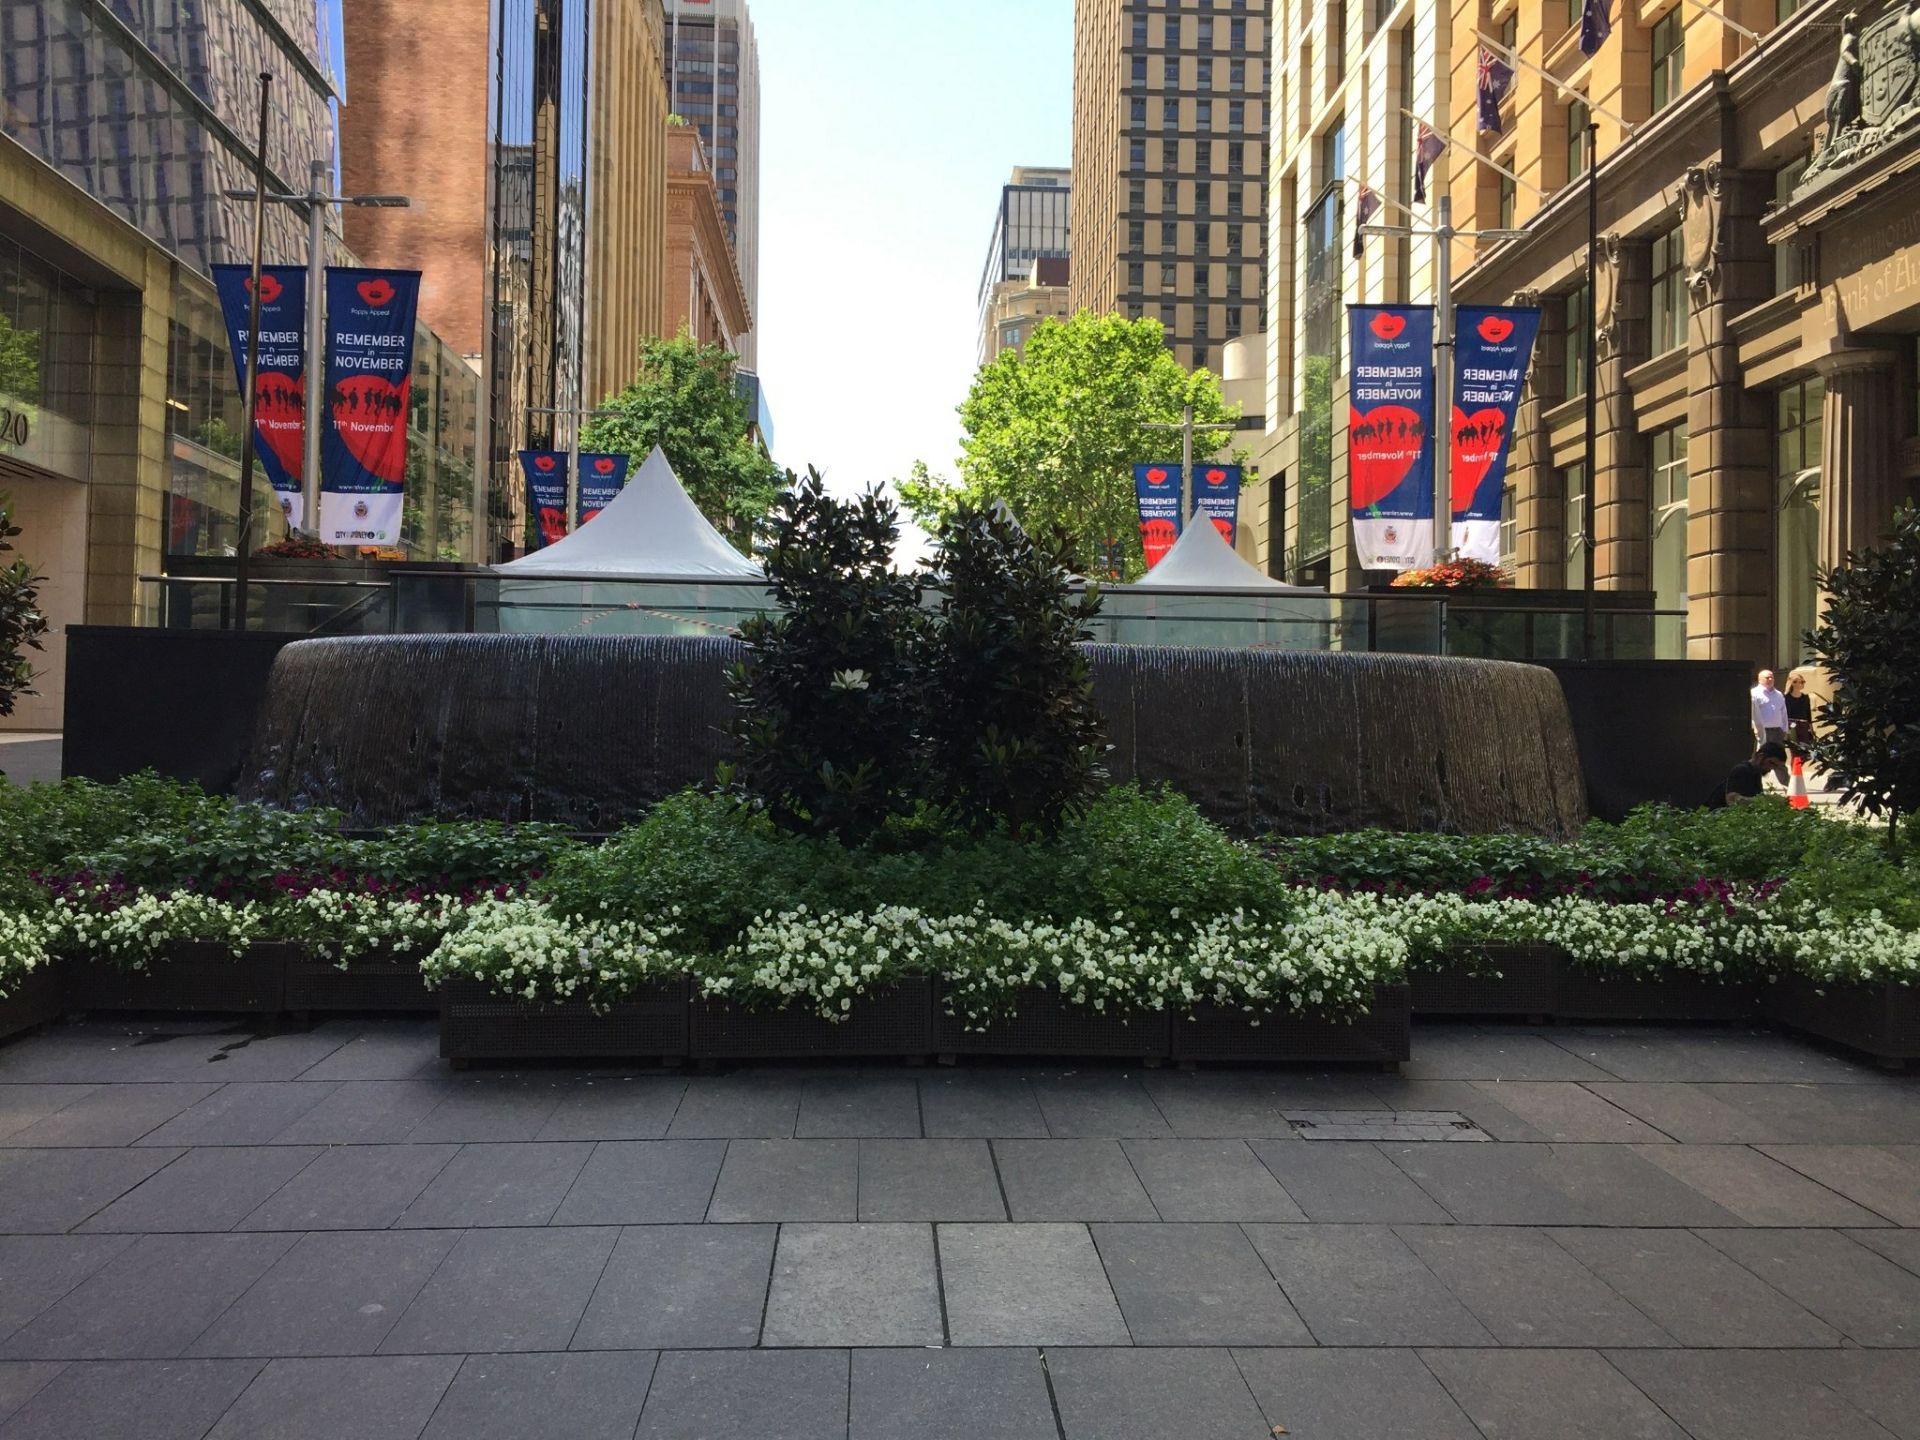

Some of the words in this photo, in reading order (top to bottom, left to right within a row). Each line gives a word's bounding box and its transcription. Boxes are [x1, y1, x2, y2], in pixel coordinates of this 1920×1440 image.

[1873, 262, 1891, 301] of
[237, 330, 299, 343] RMEMBER
[336, 332, 405, 347] REMEMBER
[367, 348, 375, 356] in
[335, 355, 404, 370] NOVEMBER
